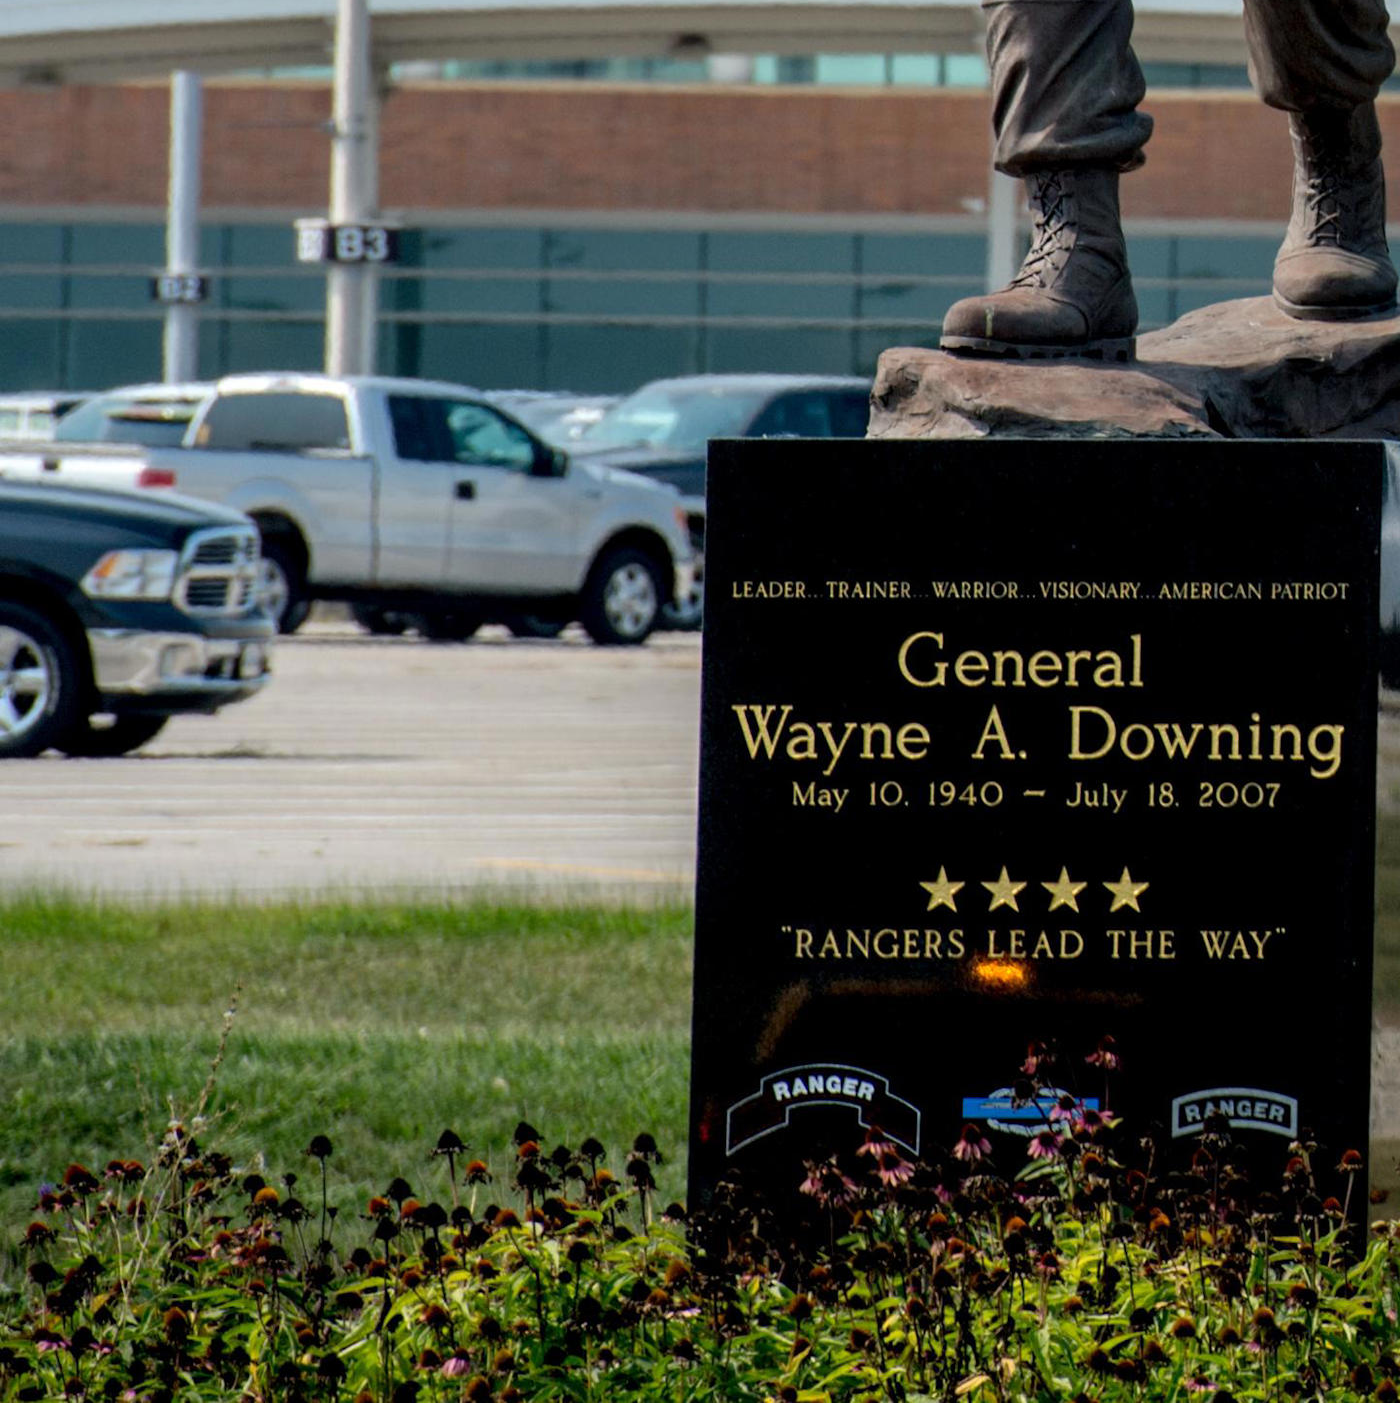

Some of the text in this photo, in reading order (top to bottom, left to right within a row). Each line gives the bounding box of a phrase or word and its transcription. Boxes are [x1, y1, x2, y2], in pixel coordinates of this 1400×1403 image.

[335, 226, 389, 261] B3
[1159, 582, 1261, 599] AMERICAN
[1271, 582, 1349, 600] PATRIOT
[899, 632, 1144, 687] General
[732, 705, 1344, 778] Wayne A. Downing
[793, 781, 849, 813] May
[930, 781, 1003, 807] 1940
[1067, 782, 1128, 814] July
[1199, 782, 1281, 808] 2007
[988, 930, 1084, 959] LEAD
[1107, 930, 1176, 959] THE
[772, 1075, 875, 1102] RANGER
